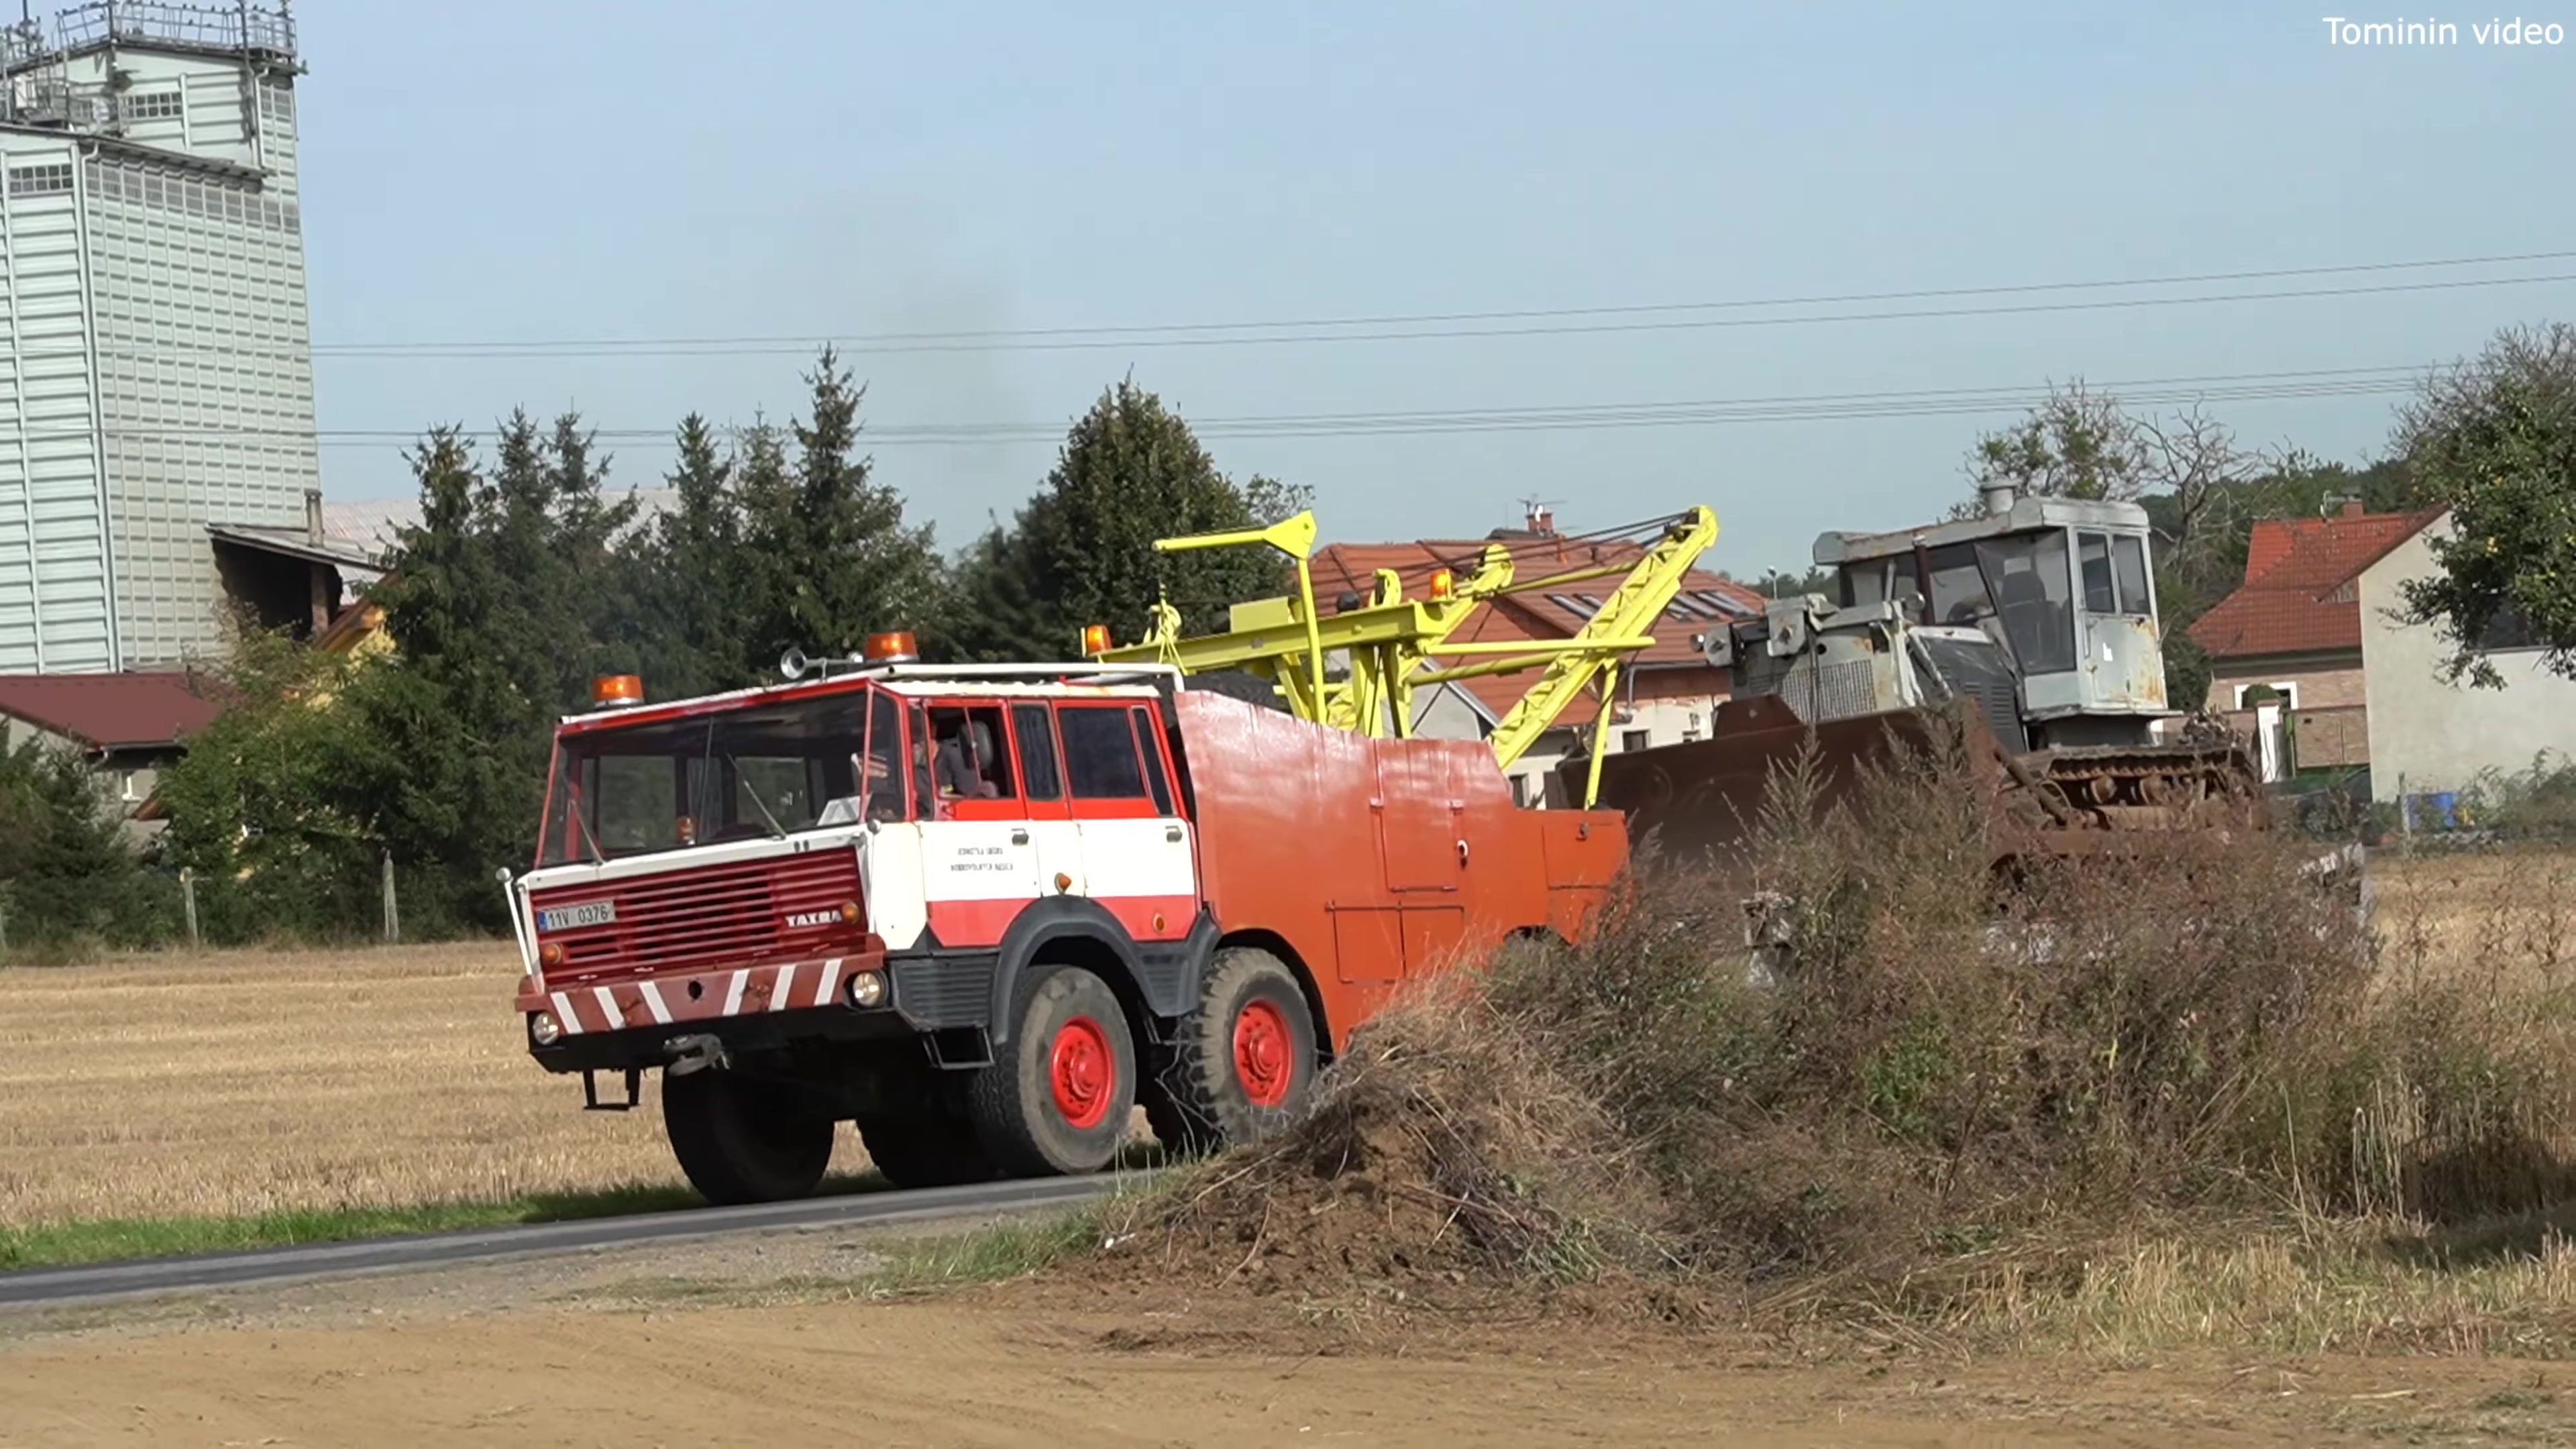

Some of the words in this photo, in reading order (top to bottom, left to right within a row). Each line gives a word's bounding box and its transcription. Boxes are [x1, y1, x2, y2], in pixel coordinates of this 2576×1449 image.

[548, 911, 570, 927] 11V
[577, 905, 609, 924] 0376
[785, 910, 843, 928] TATRA
